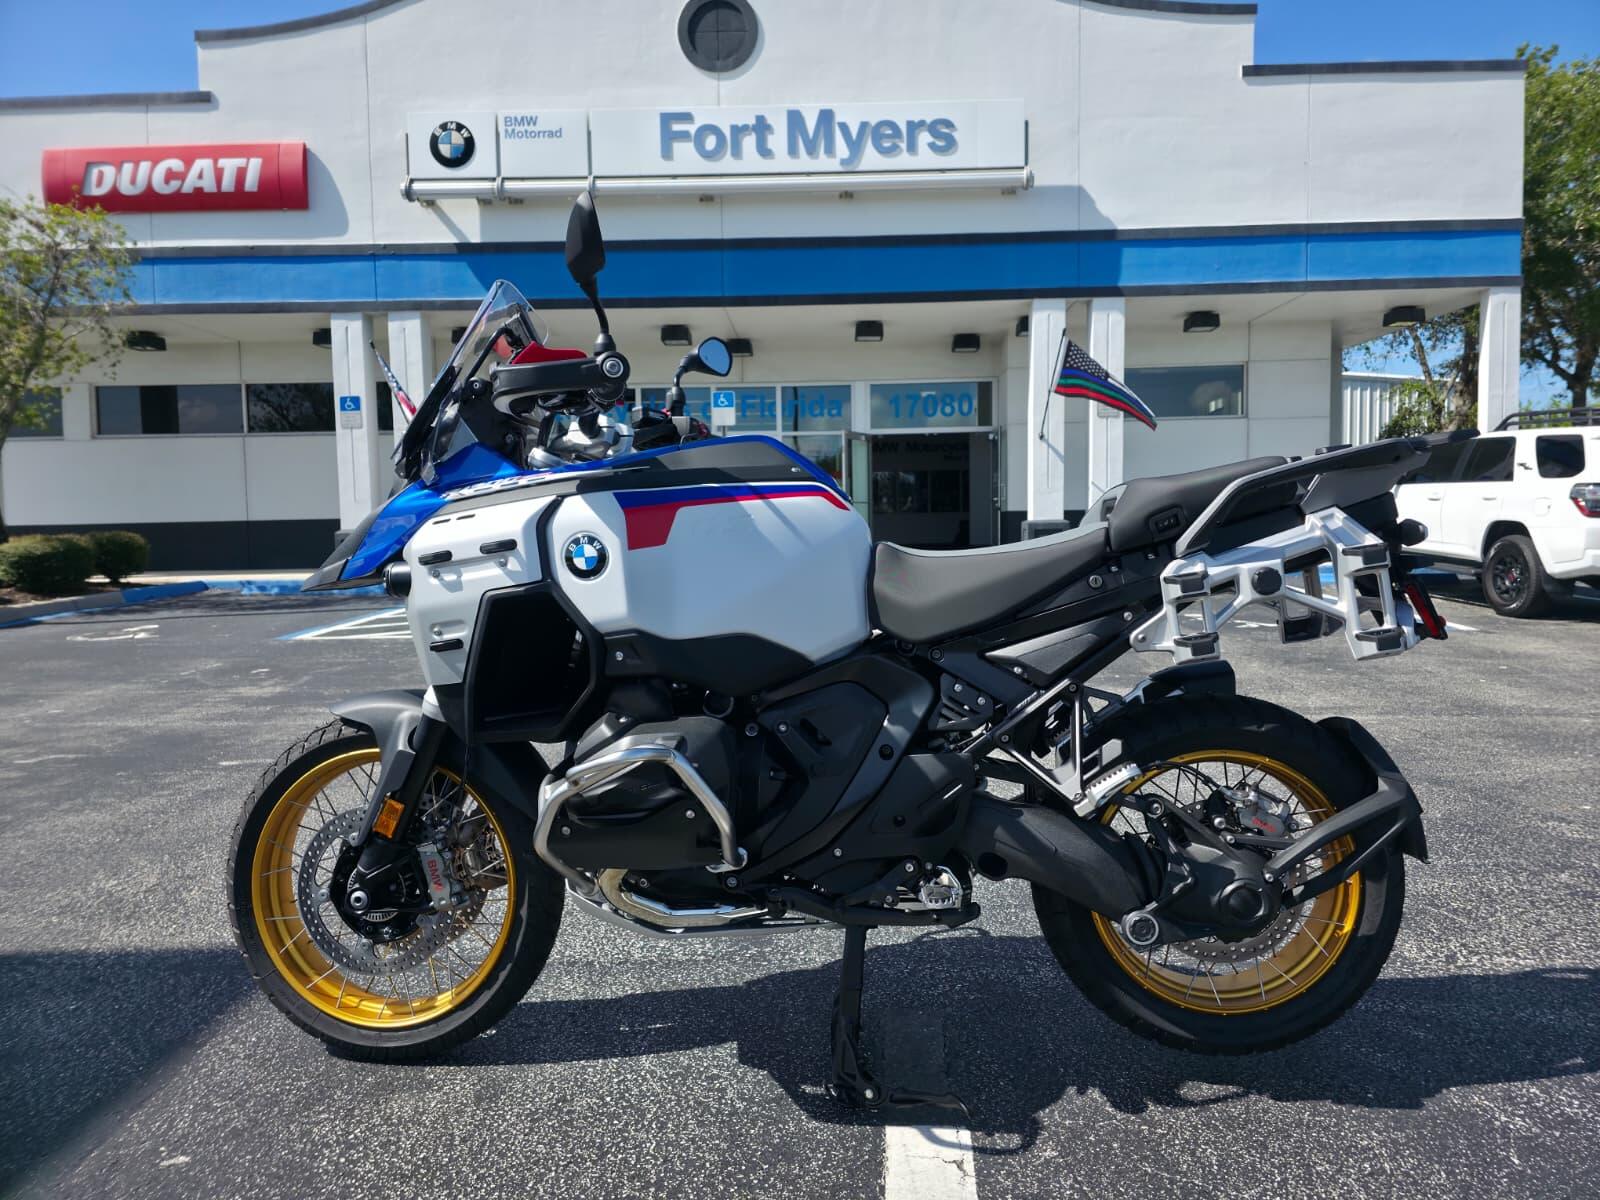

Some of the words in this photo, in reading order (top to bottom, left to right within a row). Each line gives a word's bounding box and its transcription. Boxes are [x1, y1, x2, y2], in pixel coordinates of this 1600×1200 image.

[504, 115, 538, 127] BMW
[504, 128, 563, 139] Motorrad
[659, 111, 775, 160] Fort
[786, 108, 958, 170] Myers
[81, 157, 263, 196] DUCATI
[889, 392, 974, 418] 17080
